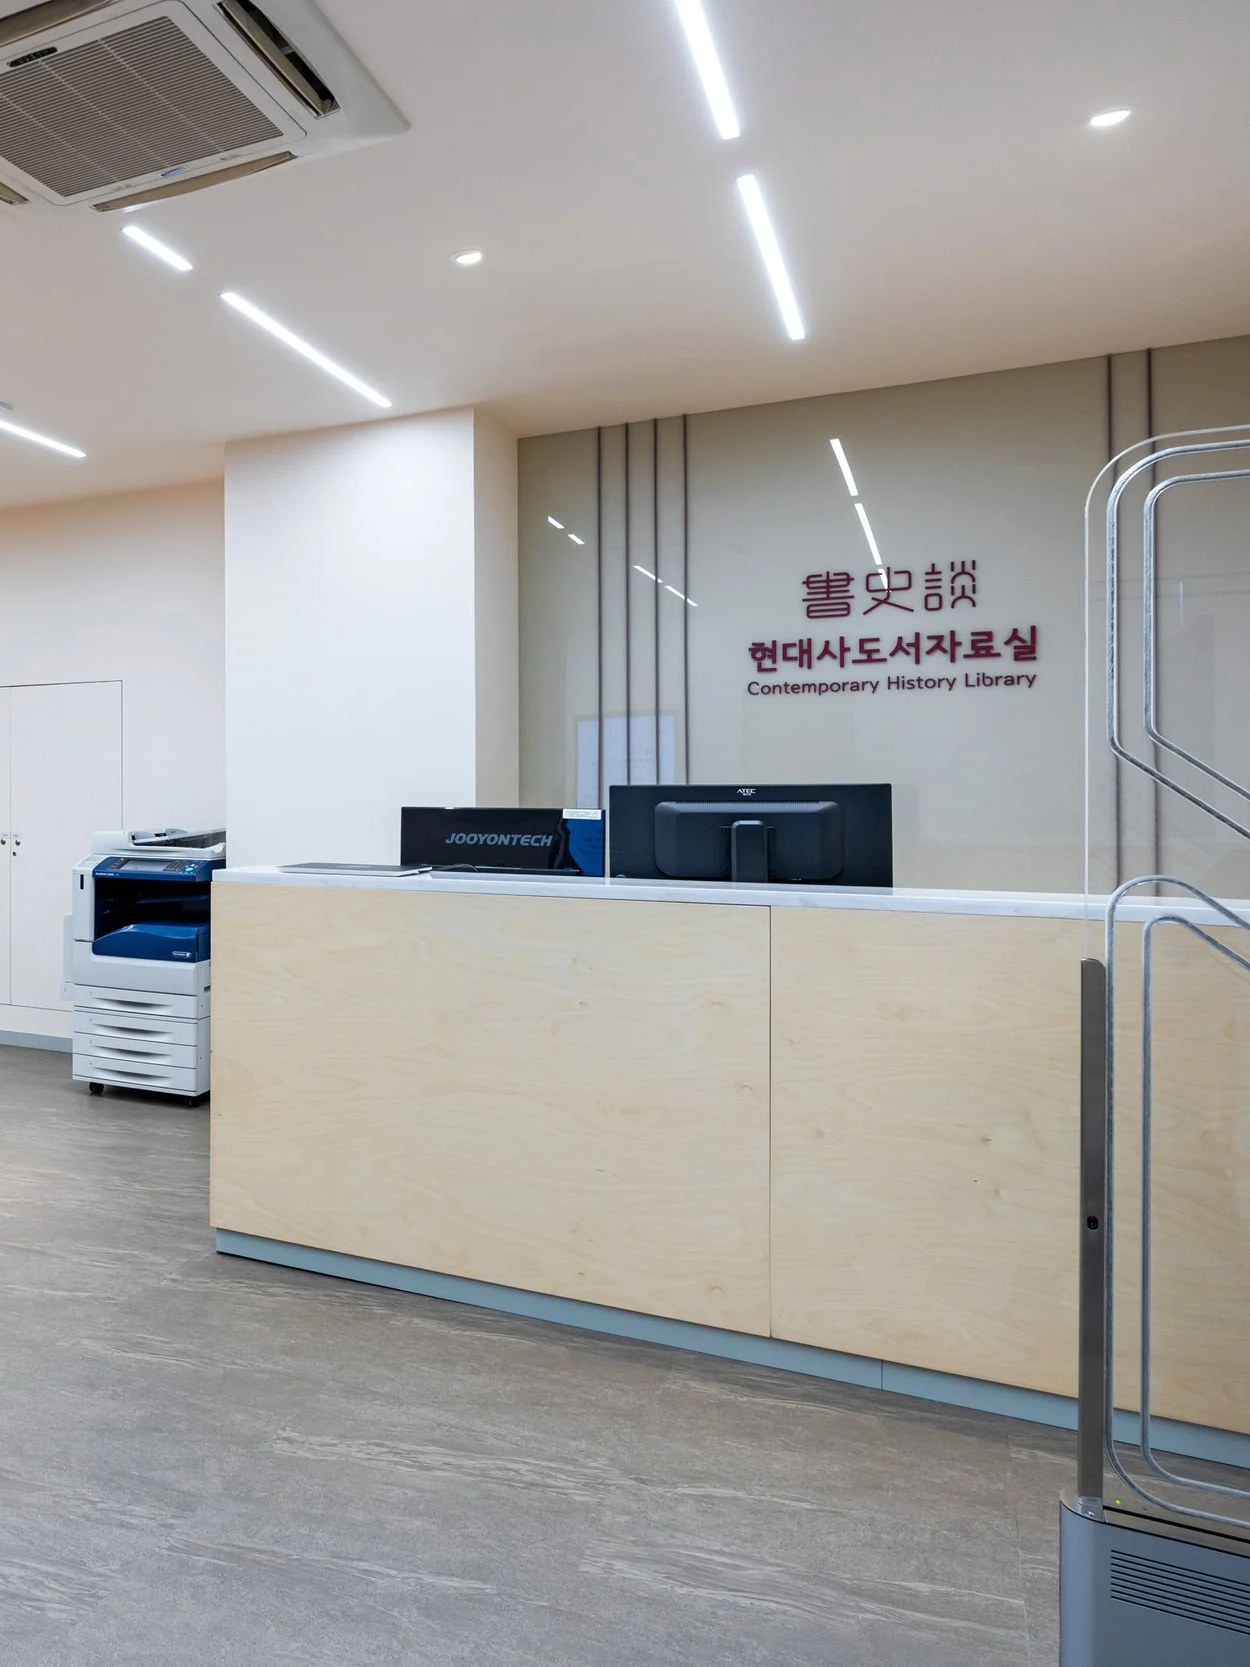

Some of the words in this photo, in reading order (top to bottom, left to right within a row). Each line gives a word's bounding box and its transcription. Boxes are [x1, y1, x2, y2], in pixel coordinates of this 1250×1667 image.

[748, 625, 1038, 672] 현대사도서자료실
[747, 679, 880, 696] Contemporary
[887, 675, 957, 691] History
[965, 671, 1037, 689] Library
[445, 832, 553, 847] JOOYONTECH
